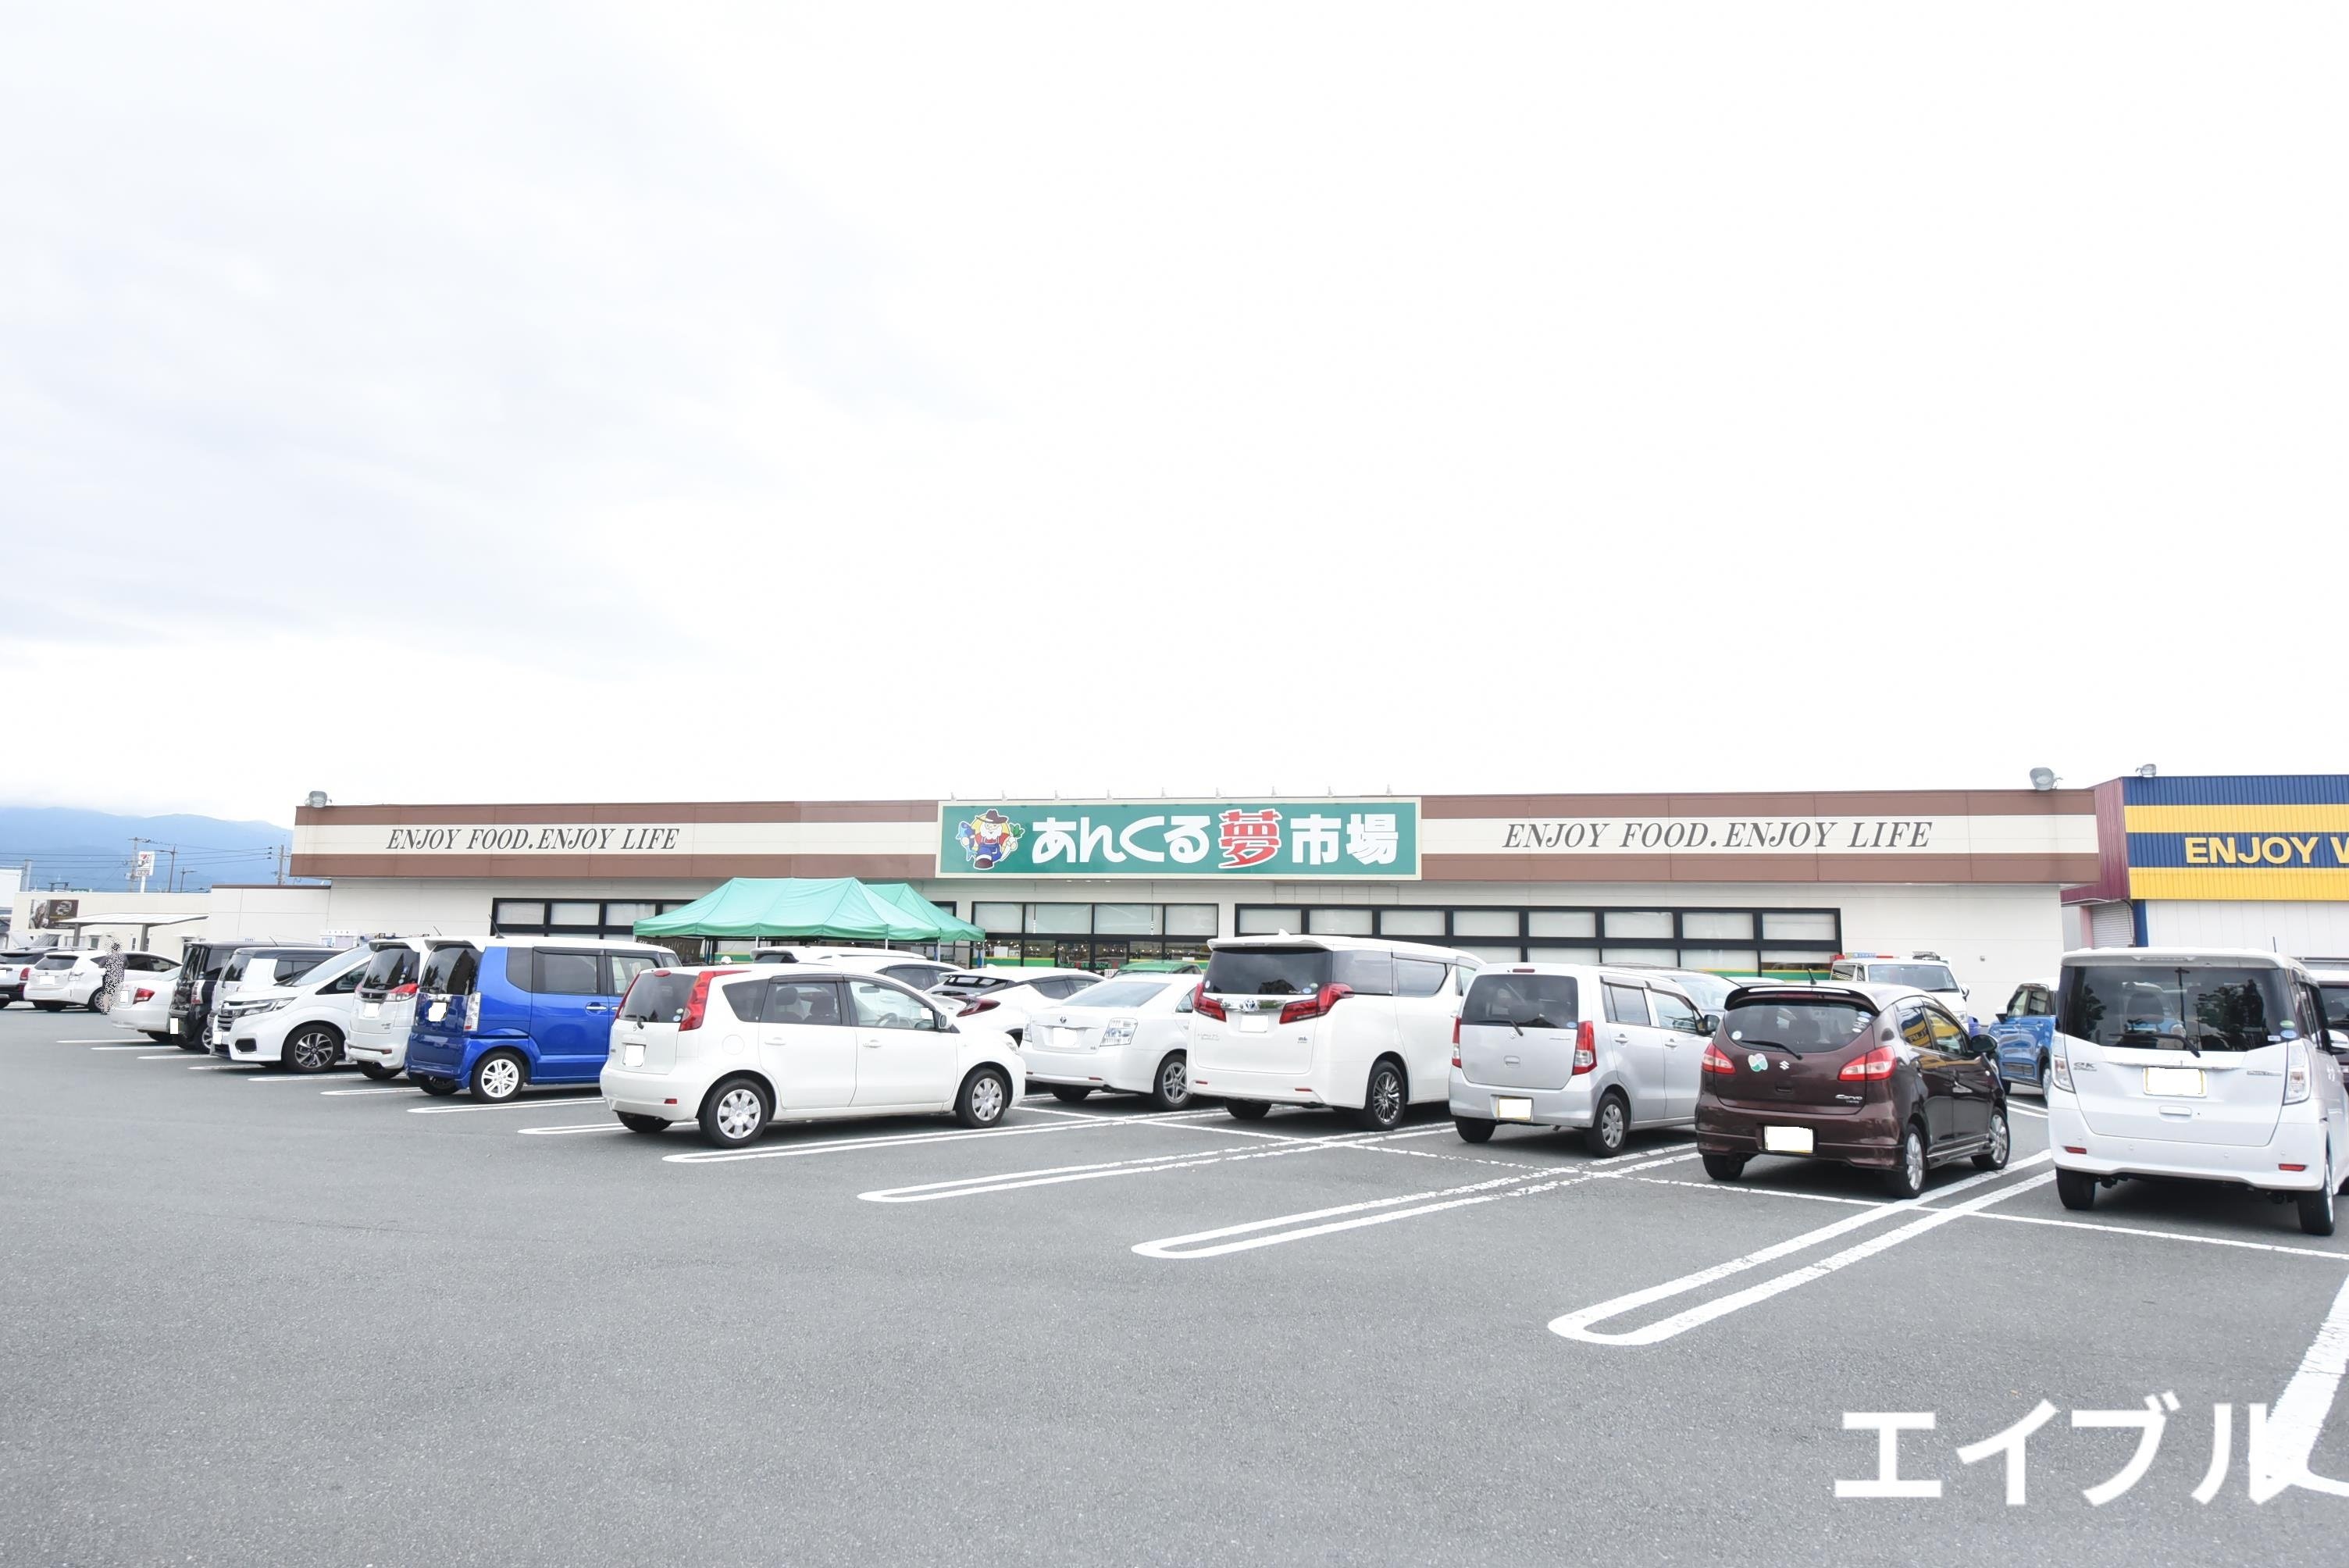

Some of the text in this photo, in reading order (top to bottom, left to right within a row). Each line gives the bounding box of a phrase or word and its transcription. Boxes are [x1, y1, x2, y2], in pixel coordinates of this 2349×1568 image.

[386, 829, 462, 850] ENJOY
[620, 828, 680, 850] LIFE
[1031, 808, 1399, 869] あんくる夢市場
[1502, 823, 1610, 848] ENJOY
[1847, 821, 1933, 847] LIFE
[2185, 836, 2319, 864] ENJOY
